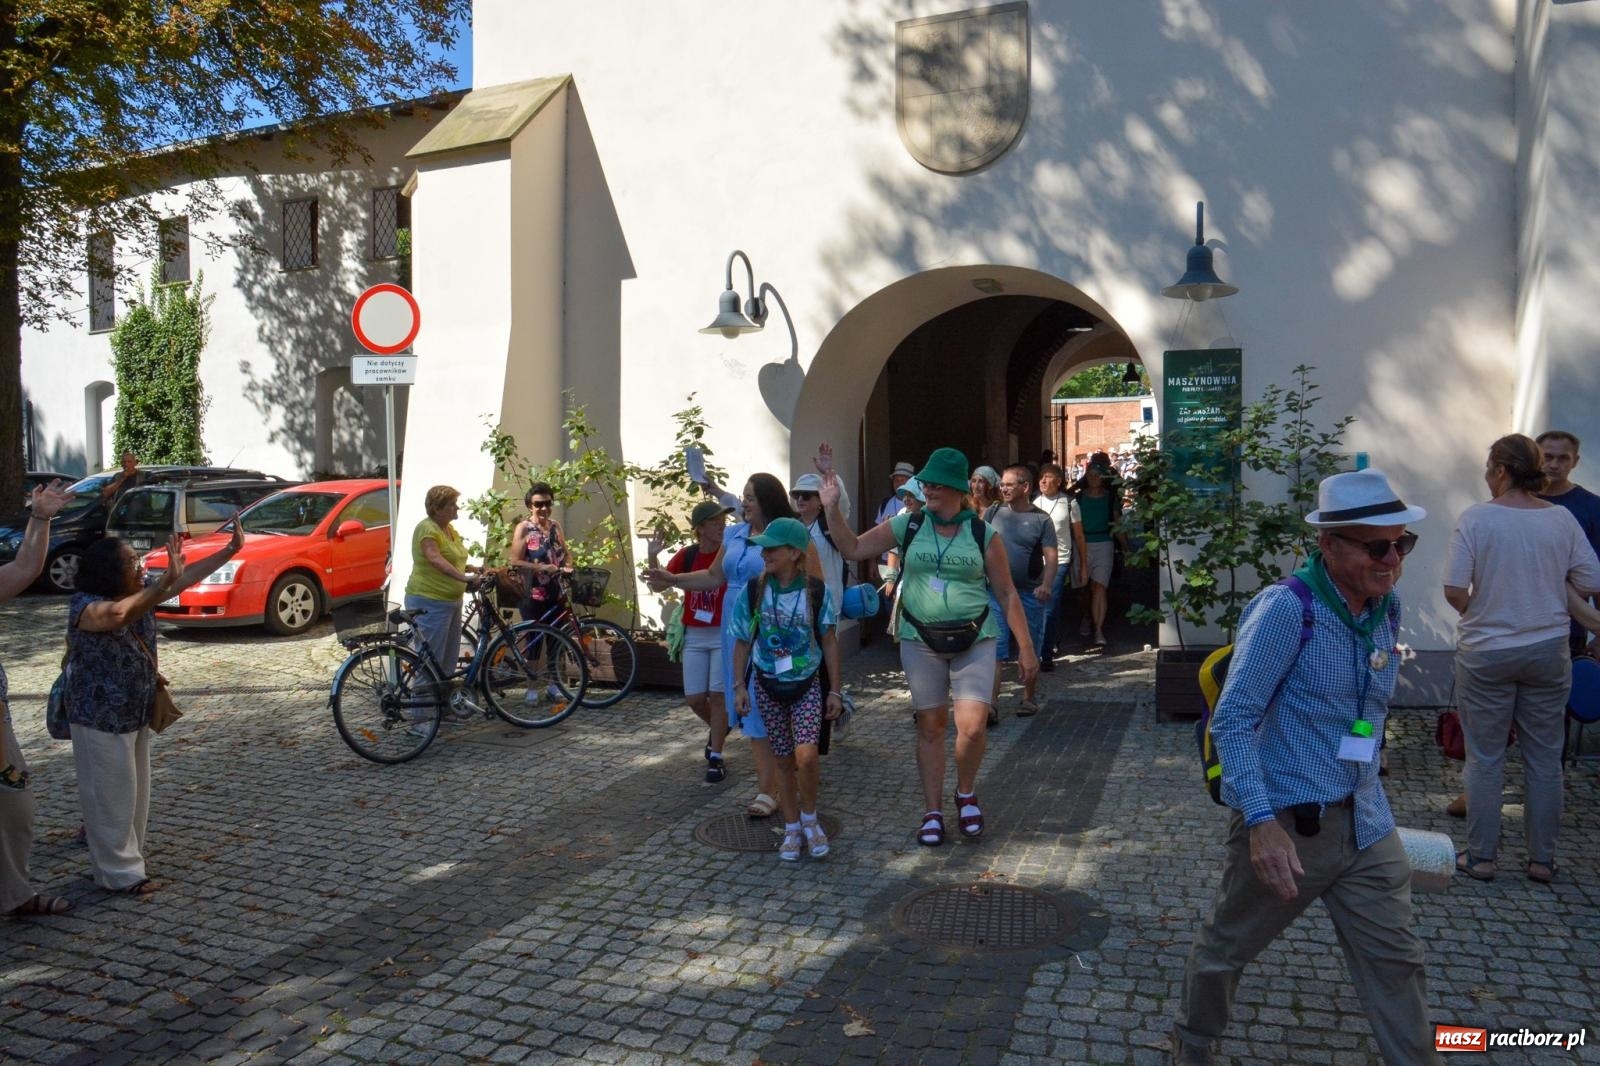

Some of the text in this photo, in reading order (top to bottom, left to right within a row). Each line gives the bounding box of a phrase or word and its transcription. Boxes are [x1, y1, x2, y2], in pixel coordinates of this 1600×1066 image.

[1167, 376, 1237, 386] MASZYNOWNIA
[915, 552, 979, 567] NEW YORK
